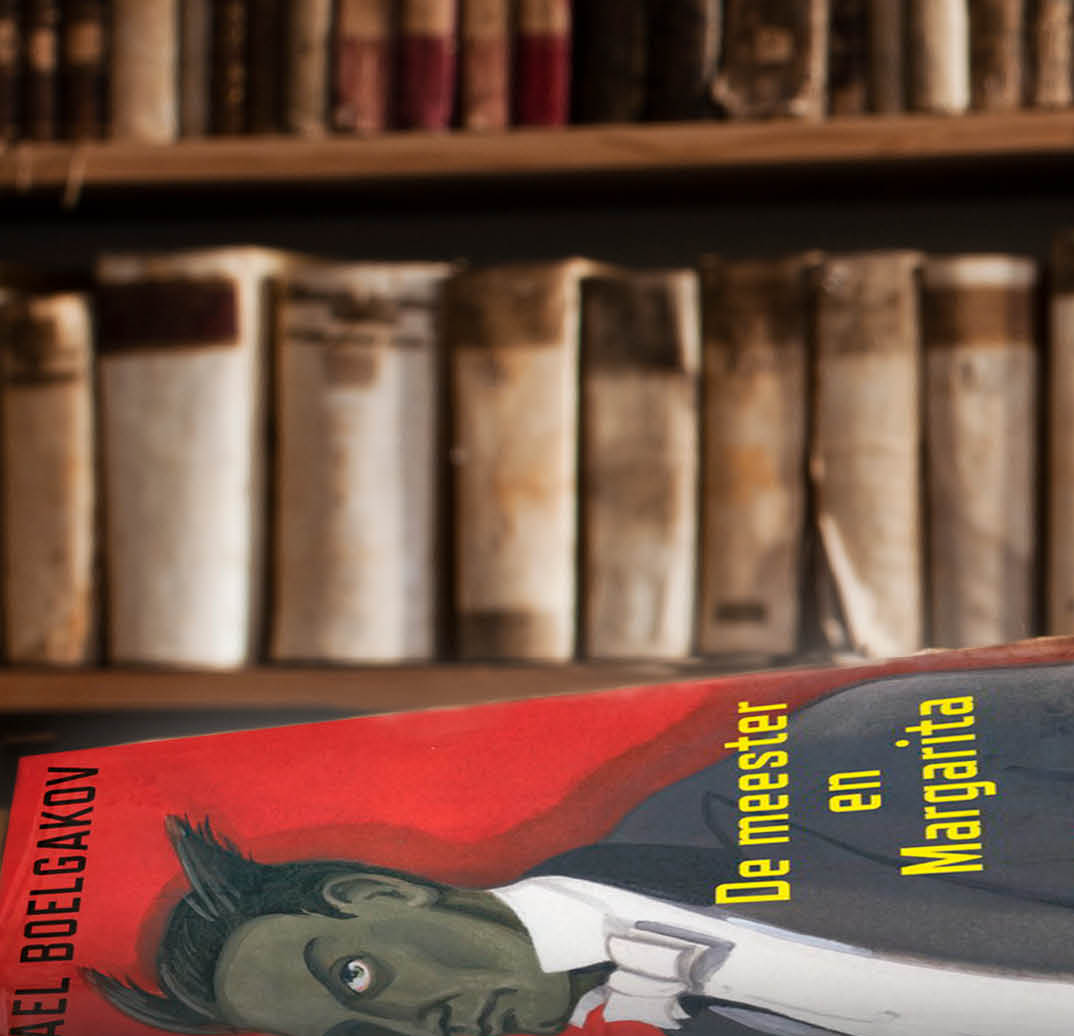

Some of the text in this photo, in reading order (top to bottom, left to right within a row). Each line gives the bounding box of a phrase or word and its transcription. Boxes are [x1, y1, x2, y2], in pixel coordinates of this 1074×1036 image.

[19, 766, 99, 964] BOELGAKOV
[714, 700, 791, 906] De meester
[827, 768, 882, 814] en
[894, 694, 997, 877] Margarita
